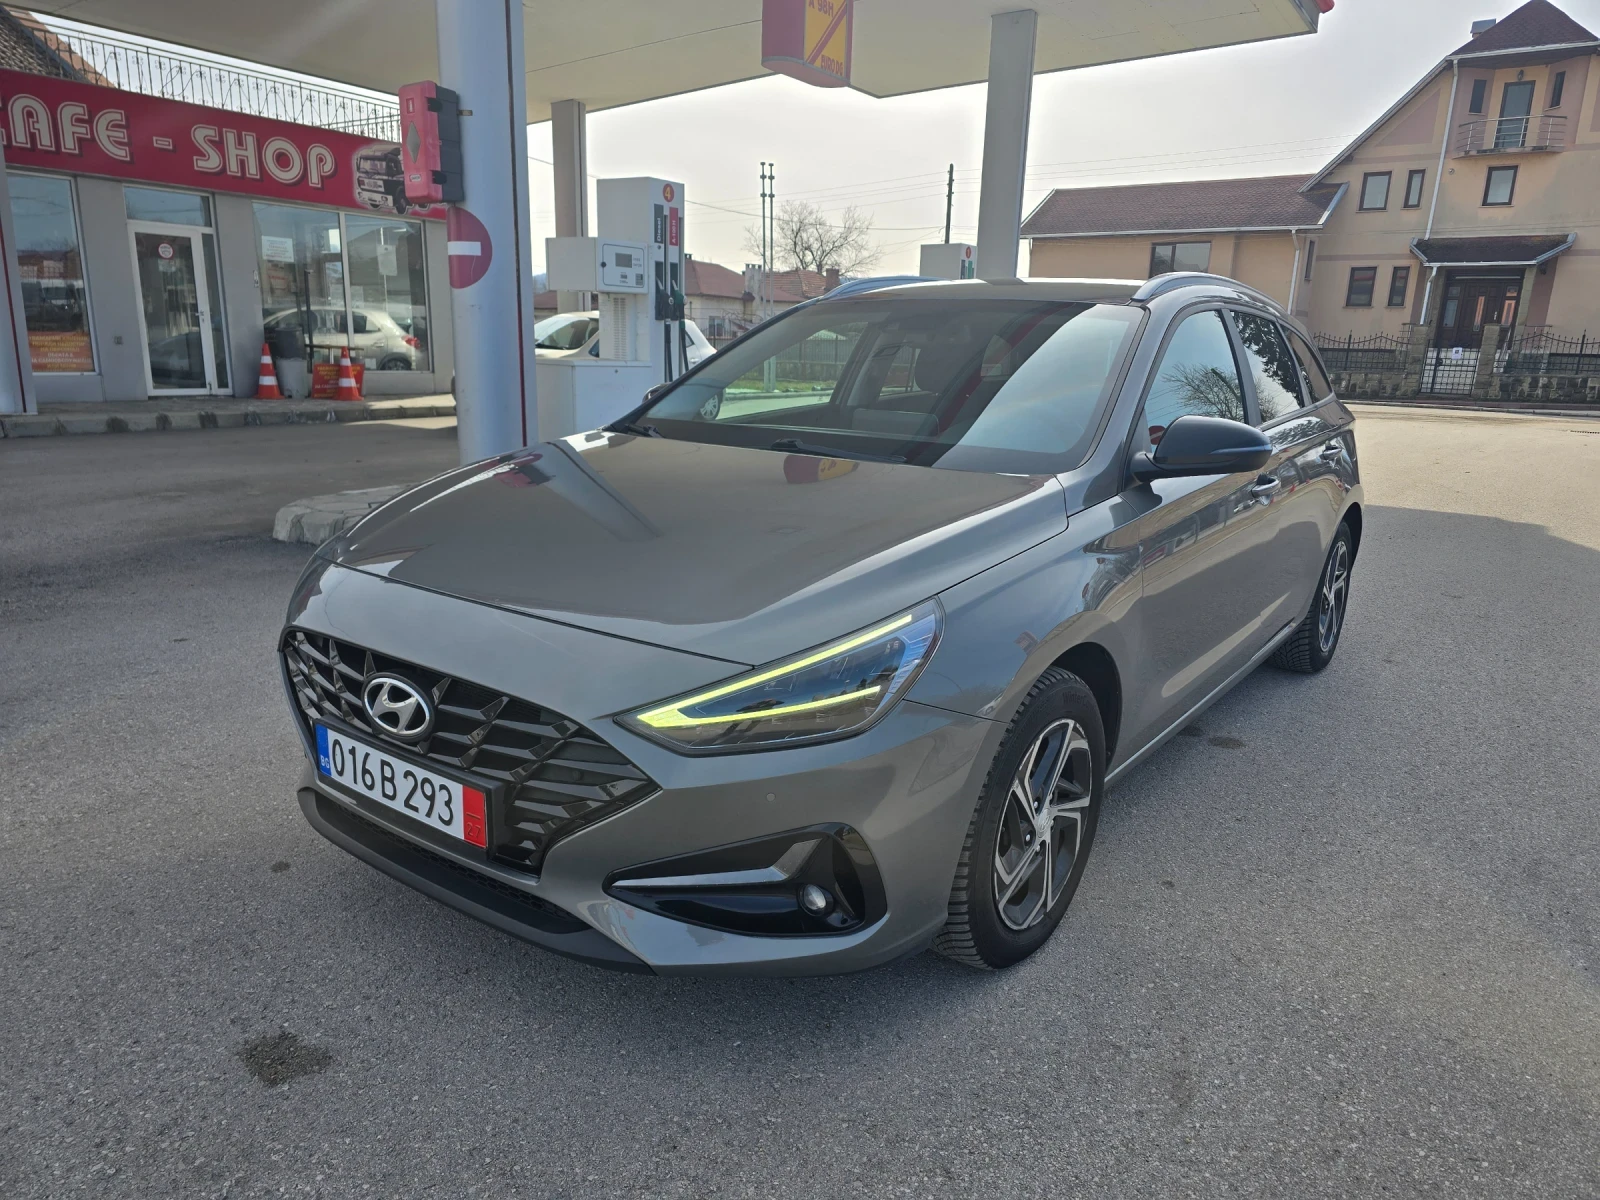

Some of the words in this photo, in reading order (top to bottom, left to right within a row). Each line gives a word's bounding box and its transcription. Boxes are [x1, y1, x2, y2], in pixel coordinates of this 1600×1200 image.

[820, 54, 835, 73] EURO
[0, 92, 130, 161] AFE
[191, 124, 335, 188] SHOP
[664, 186, 671, 200] 4
[320, 755, 330, 768] BG
